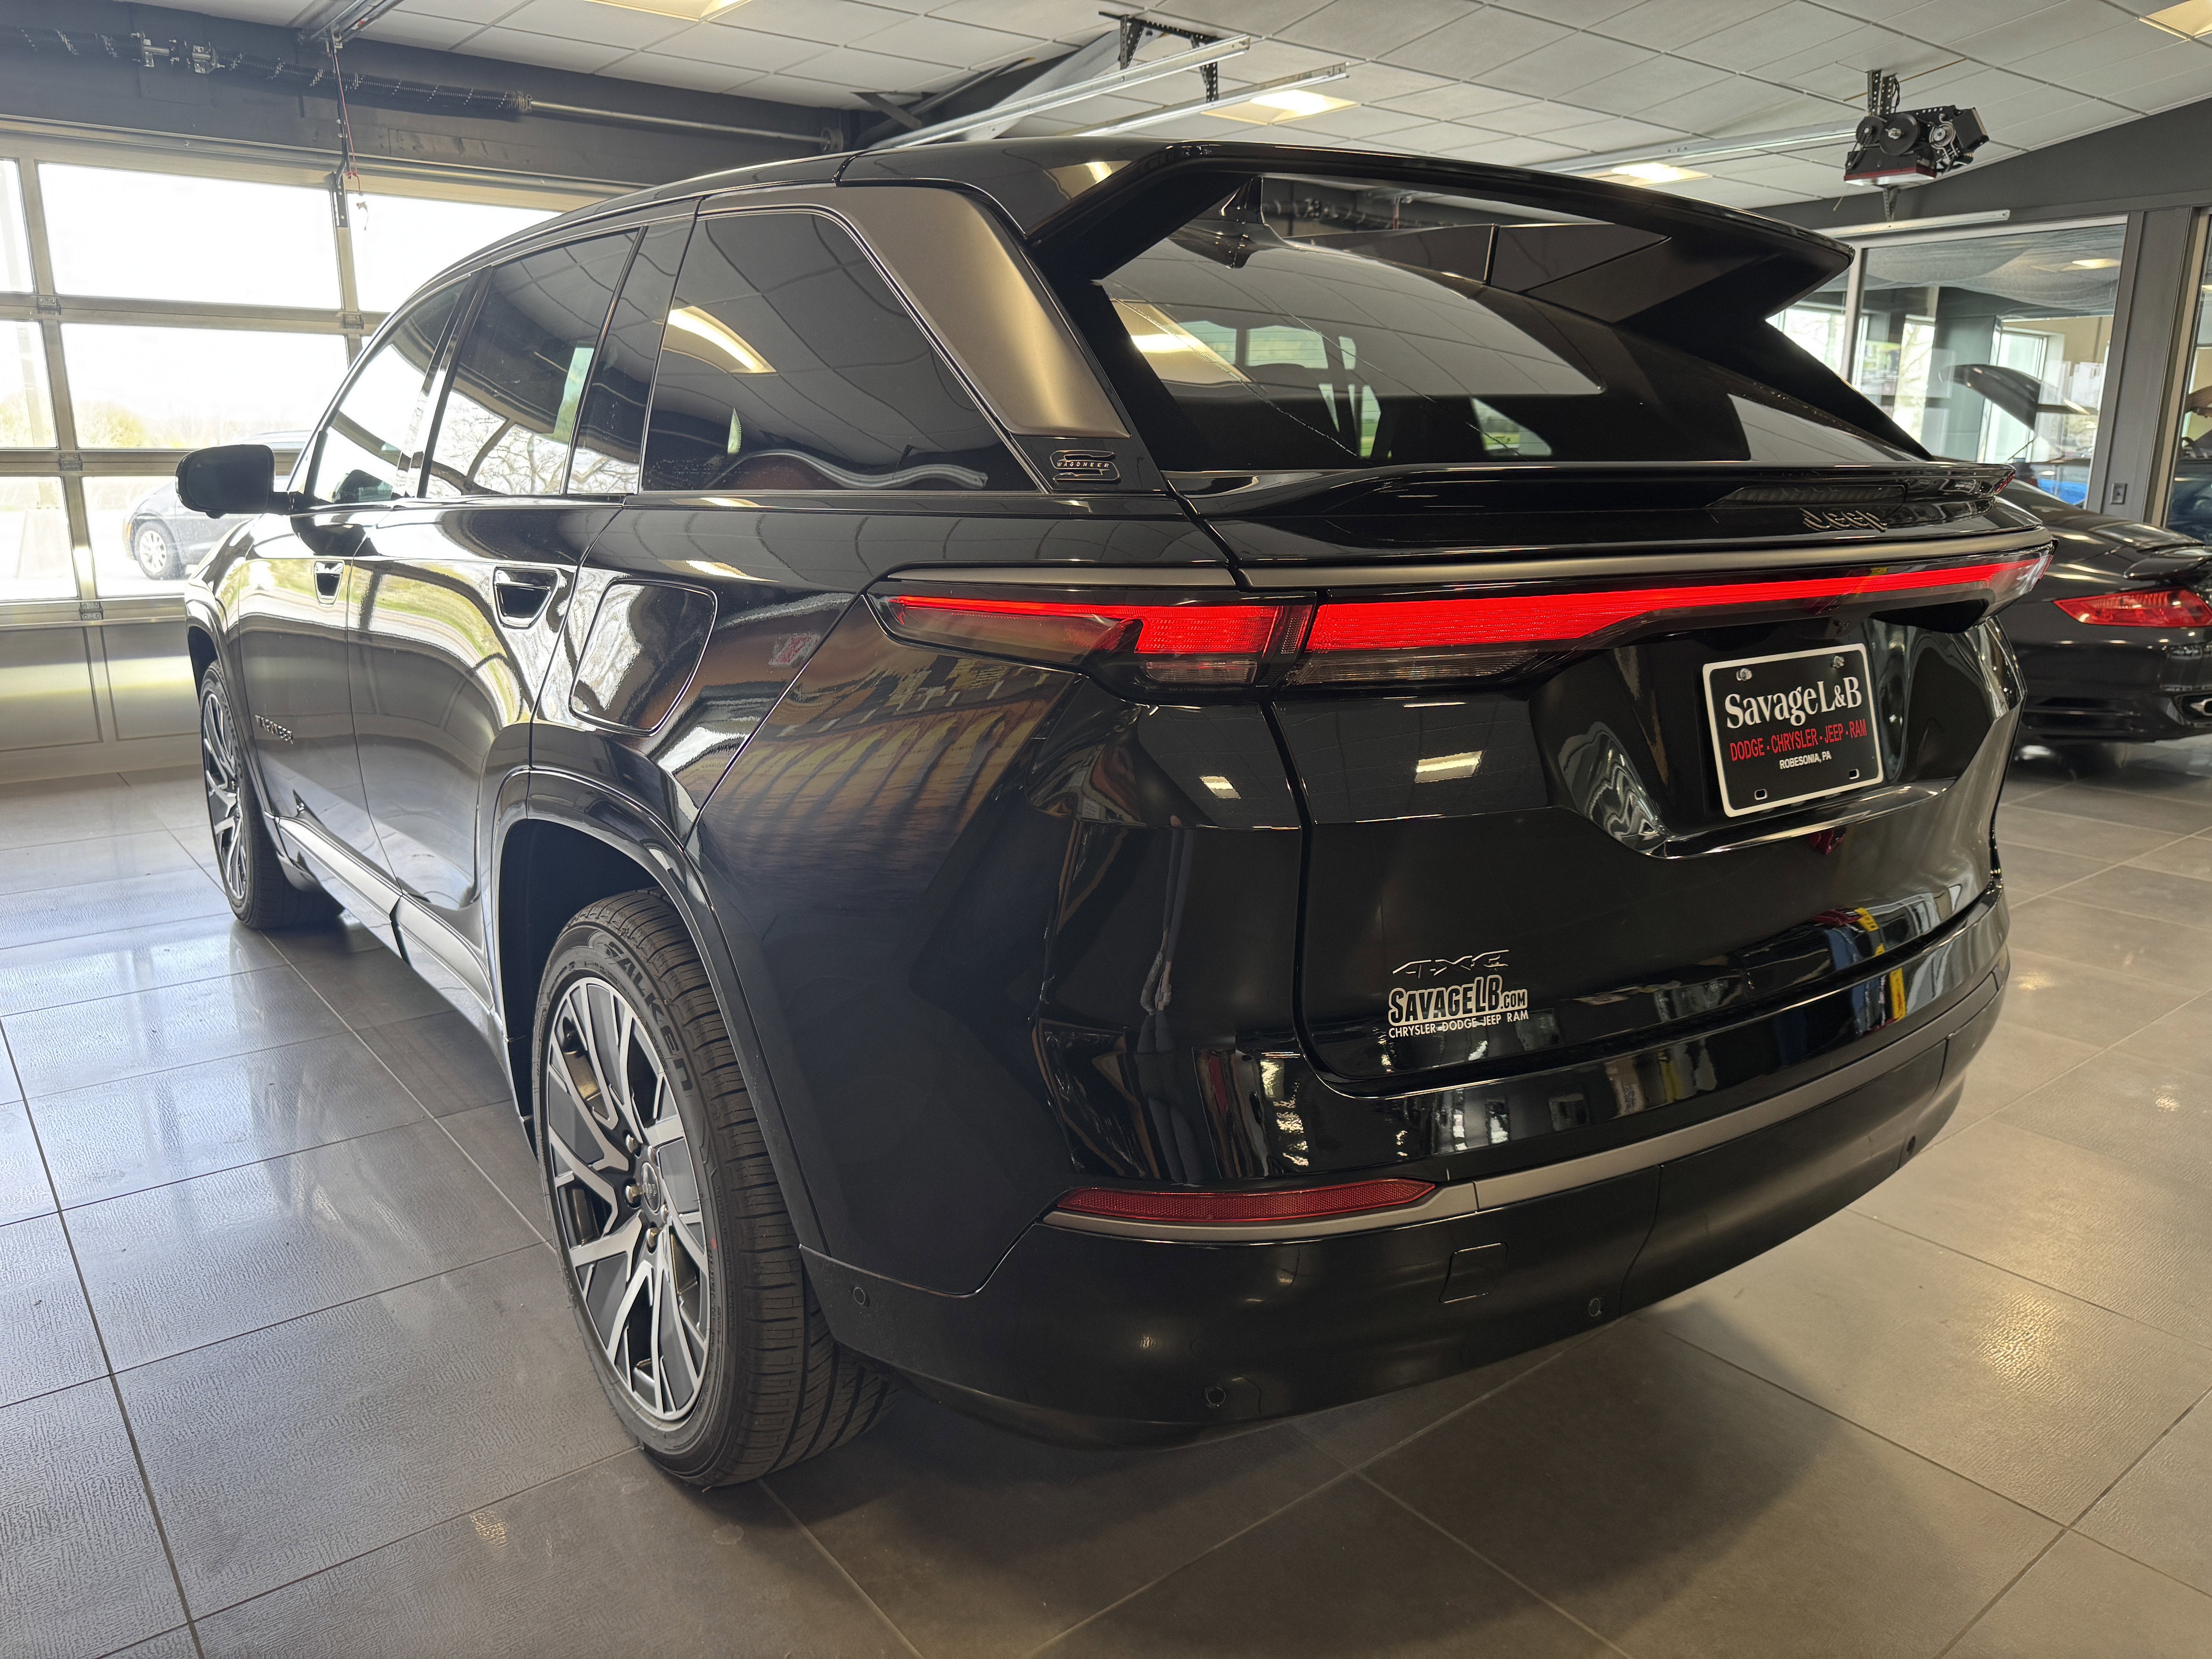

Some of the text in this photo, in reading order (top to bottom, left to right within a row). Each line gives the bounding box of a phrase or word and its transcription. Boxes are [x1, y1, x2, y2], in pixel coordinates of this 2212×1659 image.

[1729, 737, 1765, 761] DODGE
[1771, 728, 1818, 754] CHRYSLER
[1824, 723, 1843, 744] JEEP
[1849, 719, 1867, 738] RAM
[1779, 750, 1832, 769] ROBESONIA, PA
[604, 941, 694, 1091] FALKEN
[1389, 1010, 1529, 1038] CHRYSLER DODGE JEEP RAM
